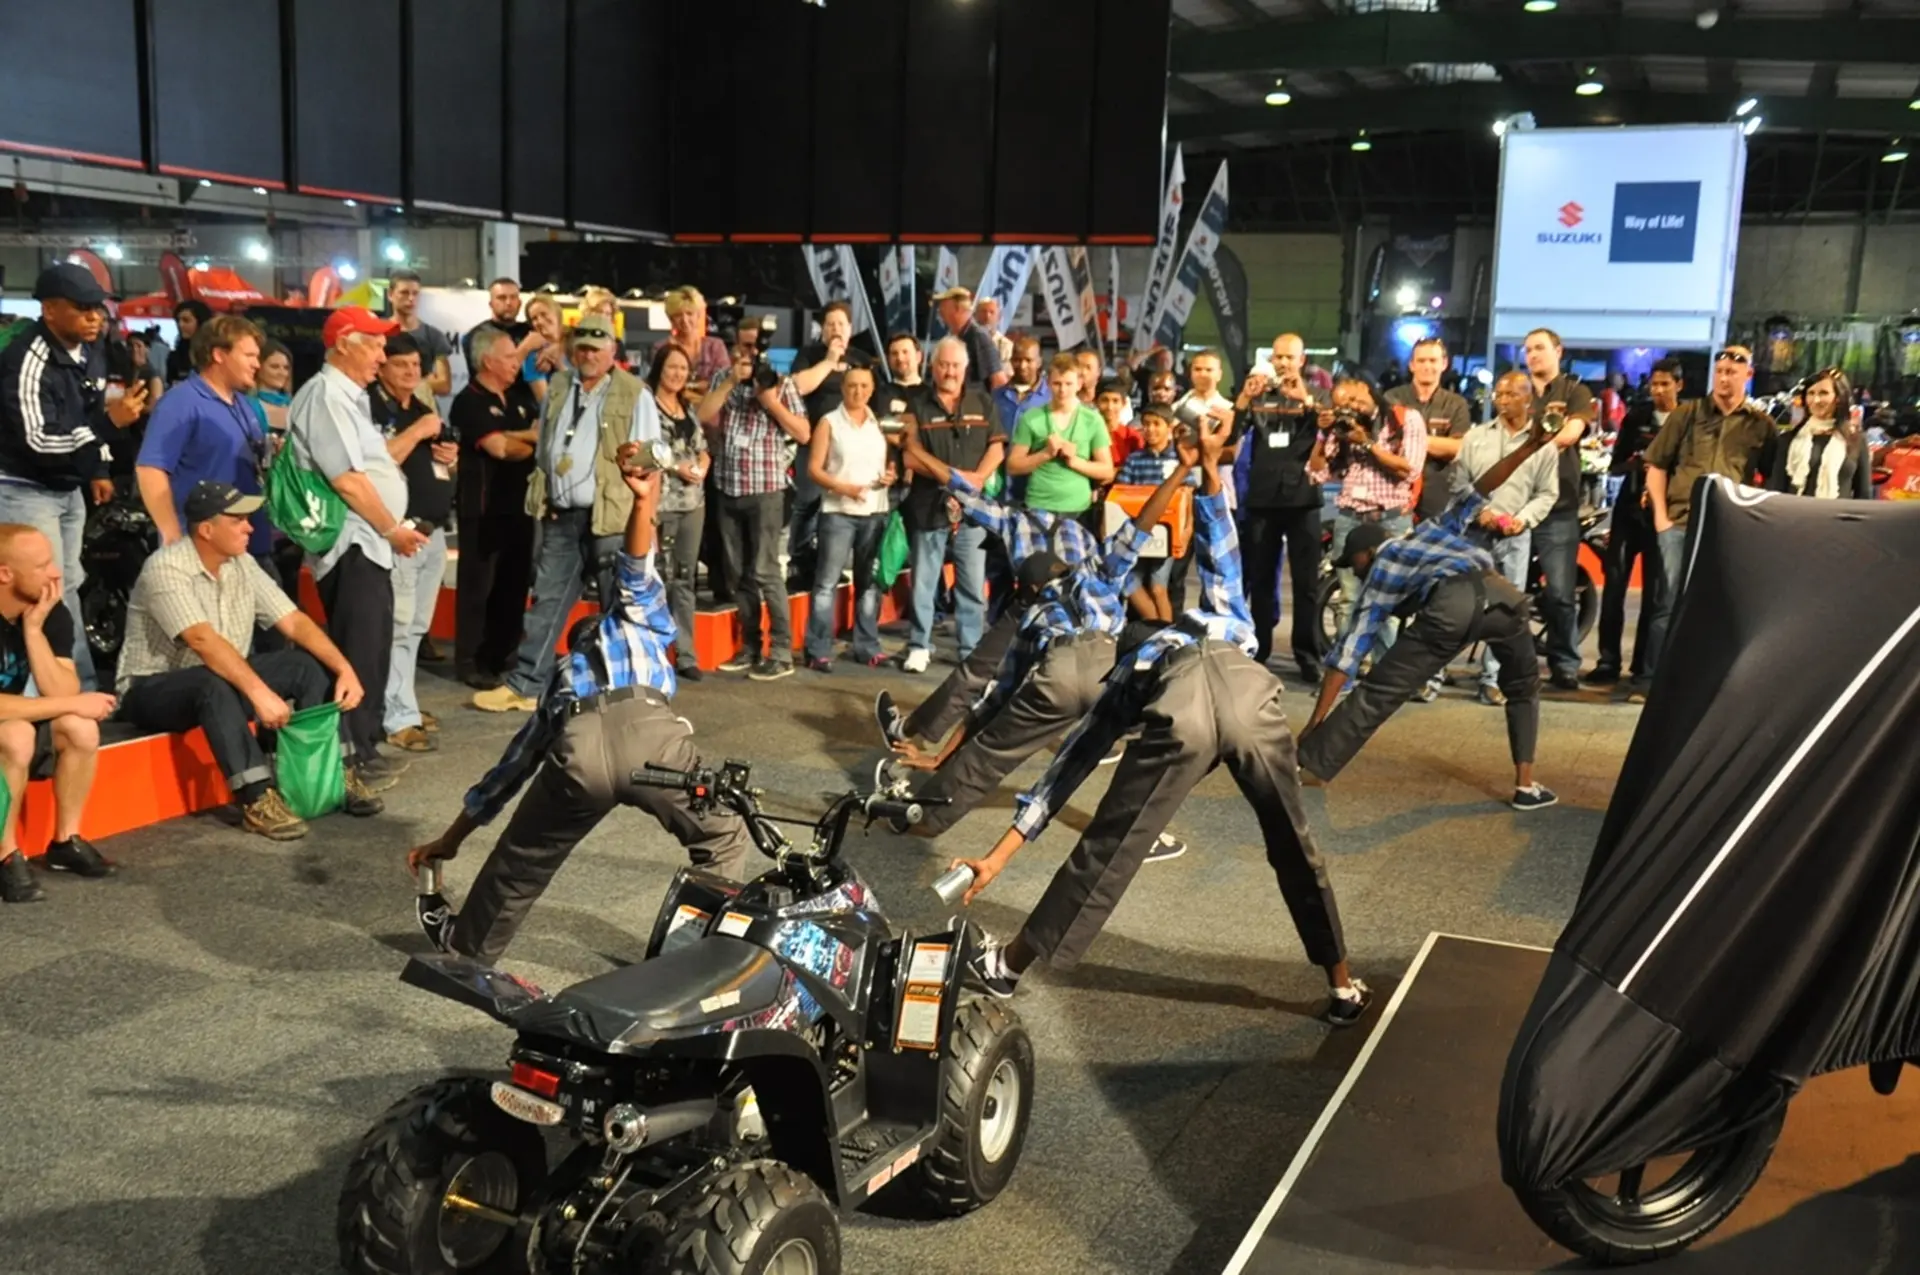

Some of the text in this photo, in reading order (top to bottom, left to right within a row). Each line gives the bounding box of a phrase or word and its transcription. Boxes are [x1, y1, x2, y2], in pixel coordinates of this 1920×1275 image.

[1624, 214, 1685, 231] Way of Life!
[1536, 233, 1602, 244] SUZUKI
